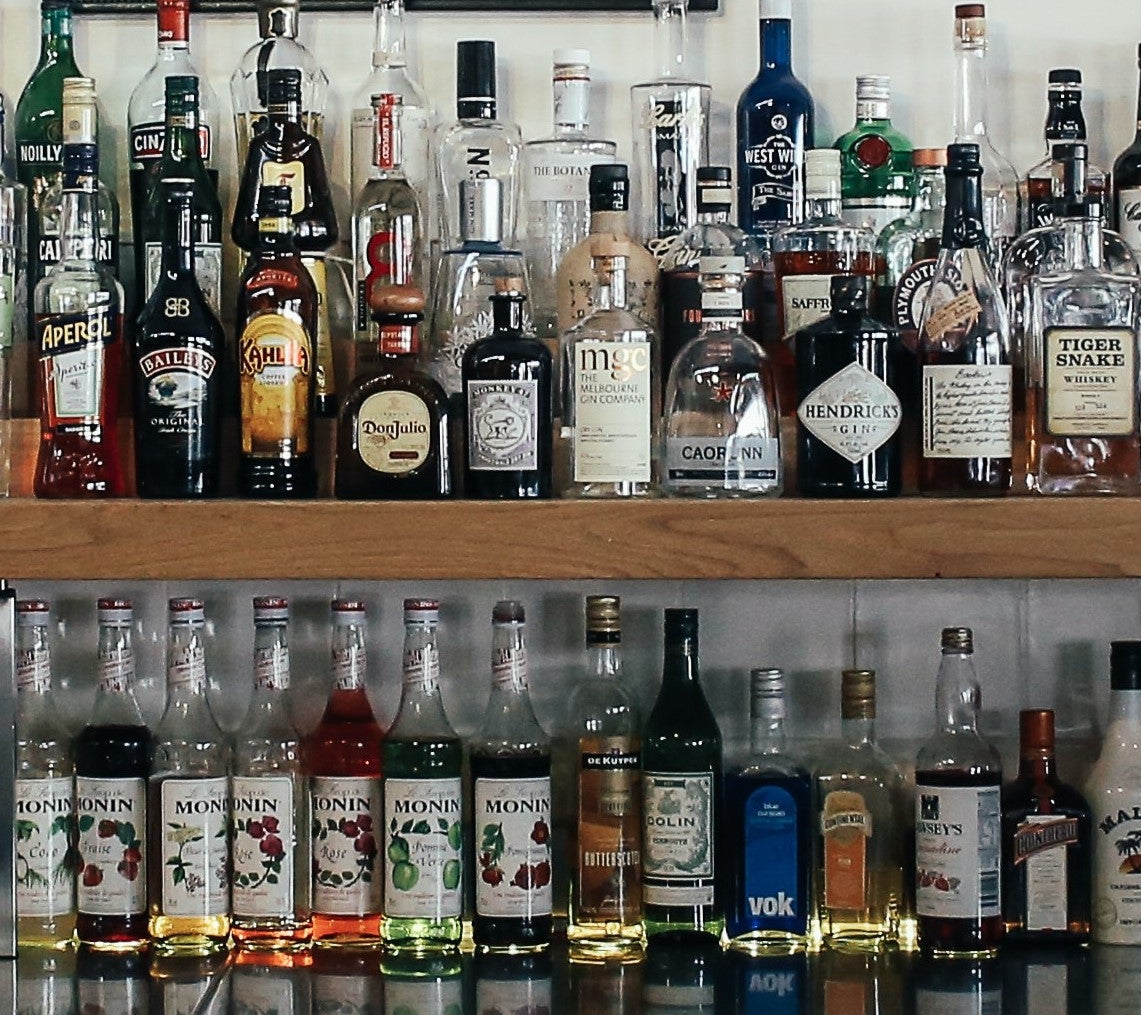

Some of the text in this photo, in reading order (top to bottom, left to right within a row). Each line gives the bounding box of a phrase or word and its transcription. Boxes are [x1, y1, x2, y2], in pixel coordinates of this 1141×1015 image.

[20, 144, 63, 163] NOILLY
[744, 148, 775, 164] WEST
[42, 316, 112, 351] APEROL
[1058, 338, 1123, 352] TIGER
[144, 348, 212, 373] BAILEYS
[580, 347, 648, 382] mgc
[1056, 353, 1126, 367] SNAKE
[580, 373, 598, 383] THE
[1063, 375, 1118, 384] WHISKEY
[580, 384, 639, 394] MELBOURNE
[580, 395, 646, 404] GIN COMPANY
[805, 404, 900, 419] HENDRICK'S
[839, 424, 870, 434] GIN
[394, 798, 461, 814] MONIN
[485, 798, 551, 814] MONIN
[748, 891, 796, 918] vok
